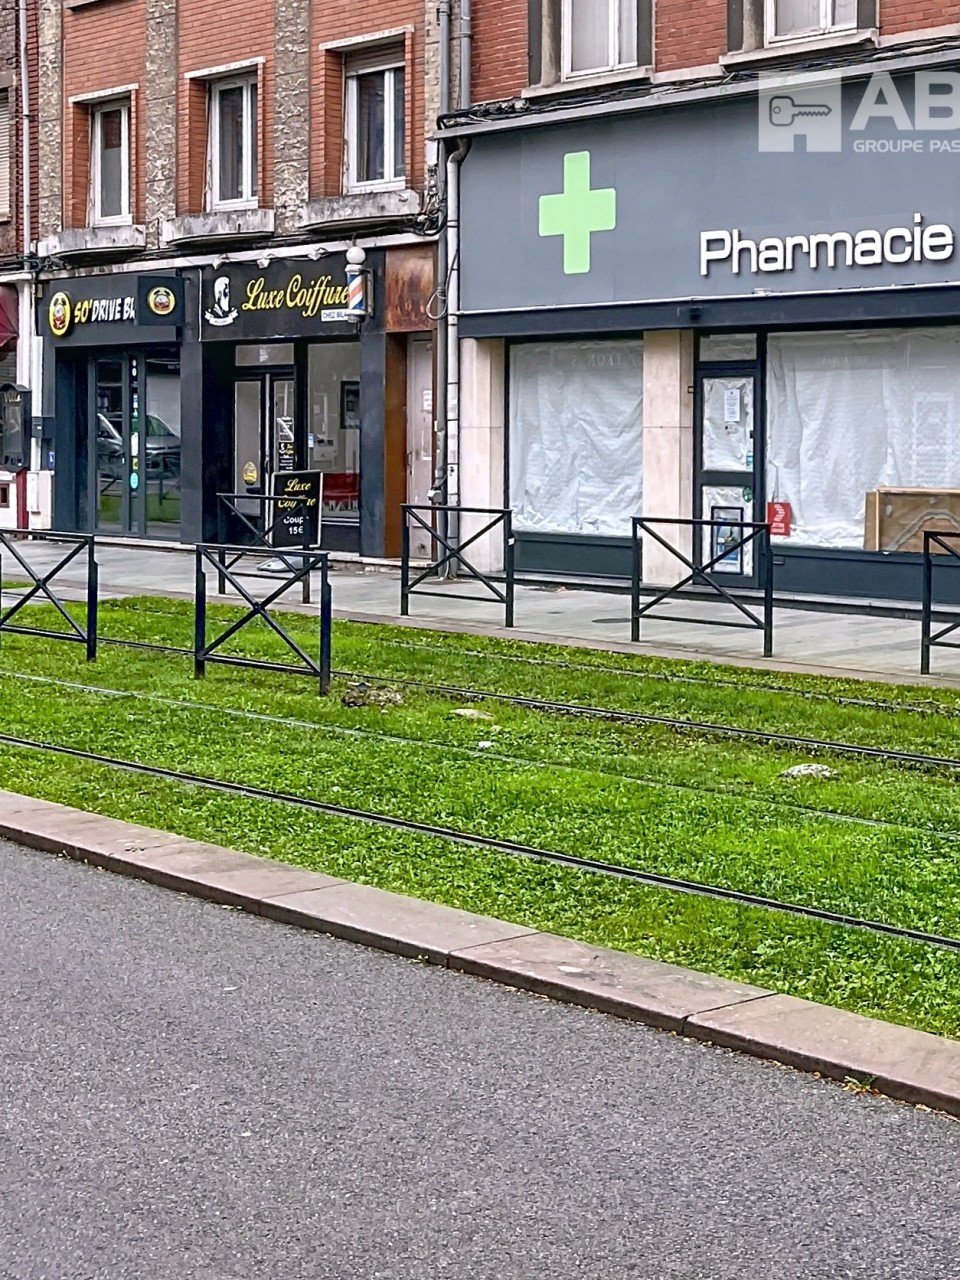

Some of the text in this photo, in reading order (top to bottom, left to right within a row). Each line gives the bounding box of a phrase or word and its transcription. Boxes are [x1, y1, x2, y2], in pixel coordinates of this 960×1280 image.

[700, 212, 955, 276] Pharmacie
[242, 274, 349, 317] Luxe Coiffure
[284, 477, 312, 491] Luxe
[288, 525, 304, 535] 15€
